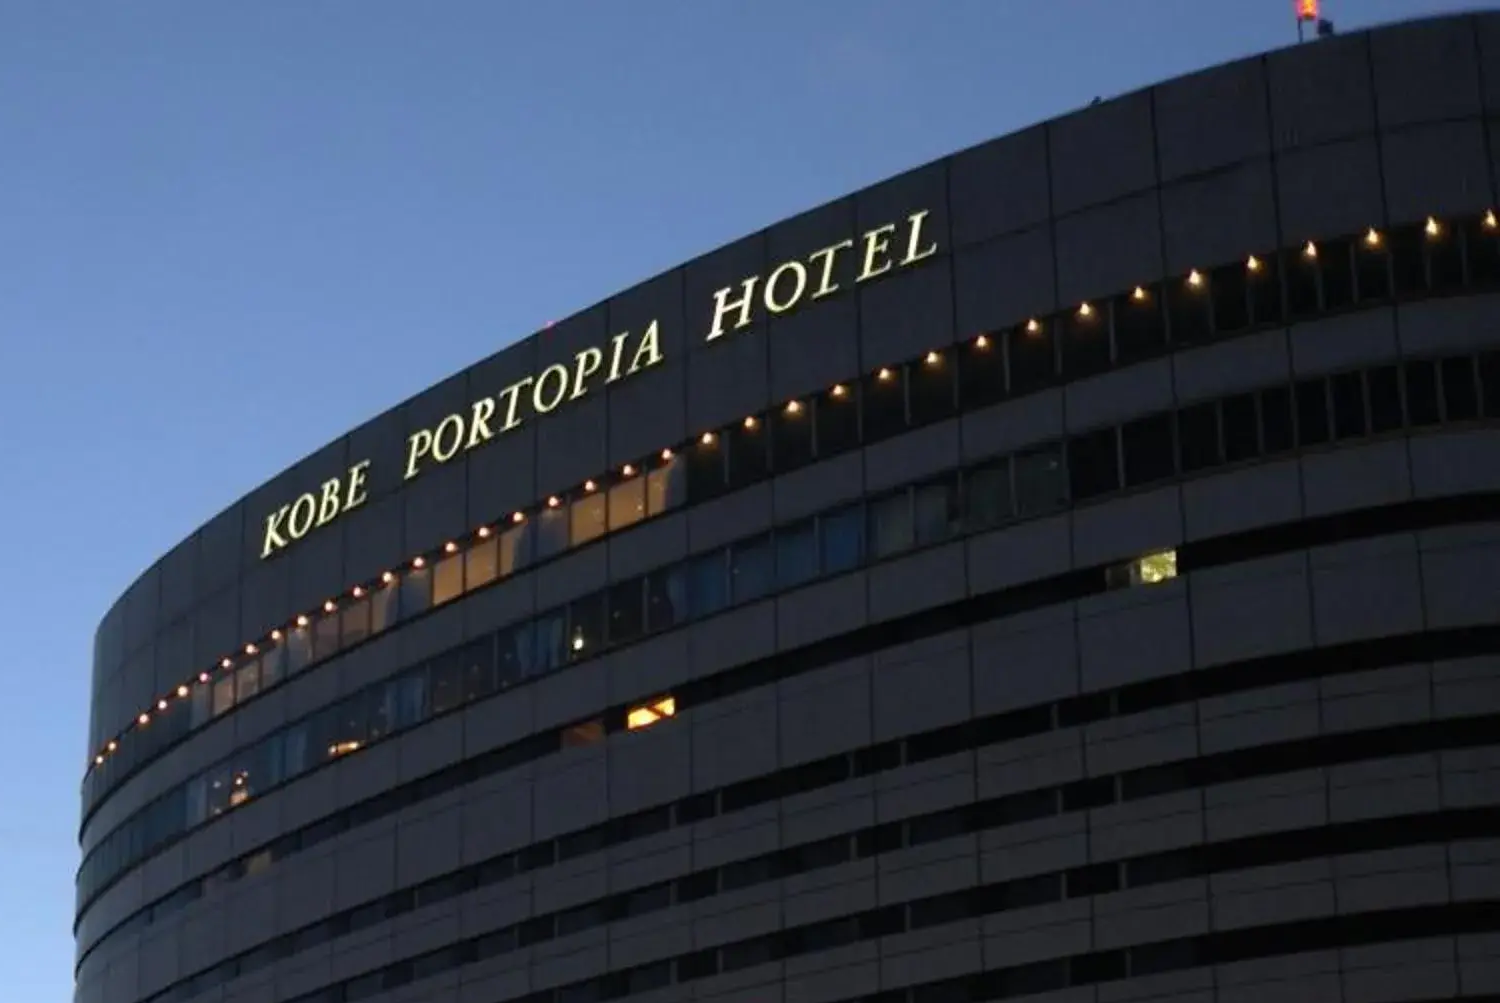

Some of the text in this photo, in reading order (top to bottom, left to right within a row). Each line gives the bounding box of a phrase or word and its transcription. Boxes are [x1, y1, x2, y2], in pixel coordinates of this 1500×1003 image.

[260, 210, 937, 558] KOBE PORTOPIA HOTEL
